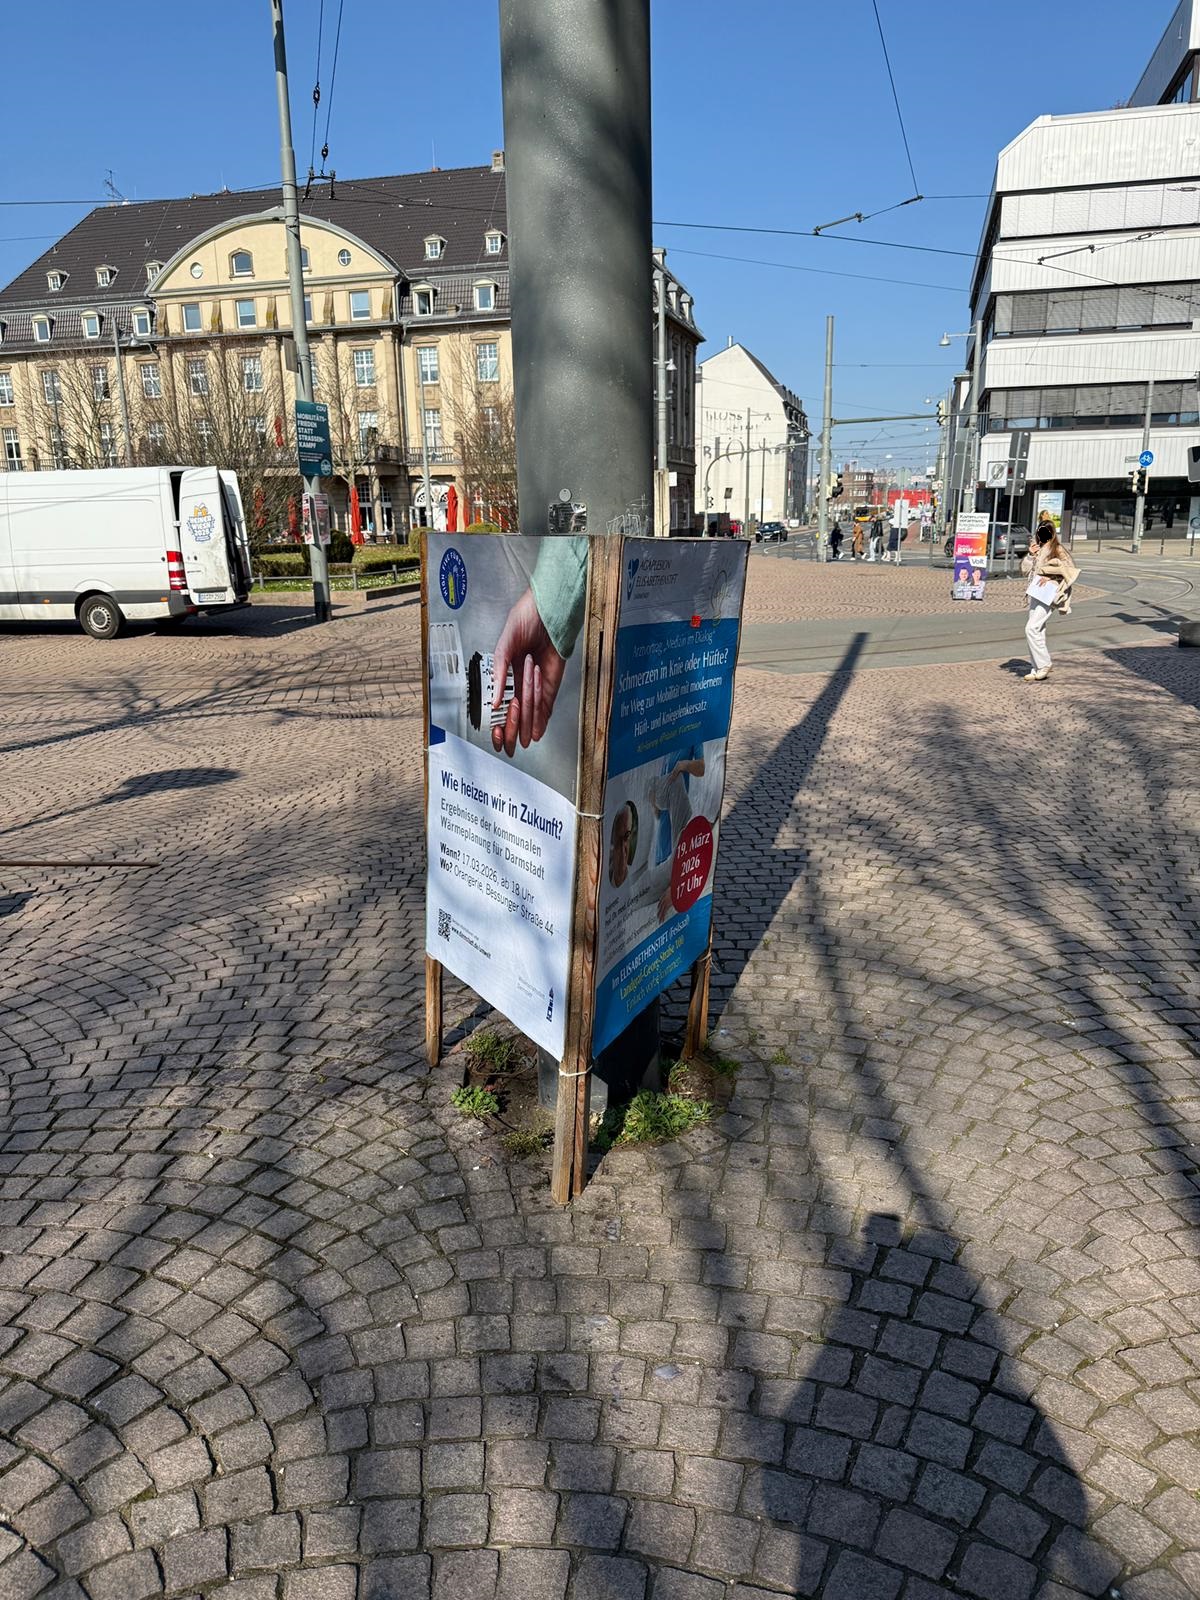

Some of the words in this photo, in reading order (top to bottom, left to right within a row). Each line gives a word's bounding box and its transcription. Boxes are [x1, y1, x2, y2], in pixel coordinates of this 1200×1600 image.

[296, 412, 326, 422] MOBILITÄTS-
[297, 420, 318, 428] FRIEDEN
[298, 434, 326, 442] STRASSEN-
[618, 668, 659, 693] Schmerzen
[660, 661, 668, 680] in
[669, 657, 684, 677] Knie
[684, 653, 701, 672] oder
[702, 648, 729, 668] Hüfte?
[620, 701, 630, 718] Ihr
[630, 697, 645, 715] Weg
[646, 695, 656, 708] zur
[656, 683, 680, 704] Mobilität
[680, 680, 690, 694] mit
[690, 676, 722, 692] modernem
[634, 717, 650, 737] Hüft-
[650, 712, 662, 731] und
[662, 700, 708, 725] Kniegelenkersatz
[441, 770, 458, 792] Wie
[460, 778, 489, 806] heizen
[491, 794, 506, 814] wir
[508, 798, 518, 819] in
[520, 803, 564, 840] Zukunft?
[440, 798, 479, 825] Ergebnisse
[480, 816, 492, 832] der
[493, 823, 542, 858] kommunalen
[440, 815, 491, 854] Wärmeplanung
[492, 840, 504, 857] für
[504, 847, 545, 881] Darmstadt
[676, 844, 688, 860] 19.
[690, 832, 711, 852] März
[440, 842, 460, 861] Wann?
[462, 853, 499, 884] 17.03.2026,
[500, 876, 510, 890] ab
[511, 880, 520, 896] 18
[522, 888, 535, 904] Uhr
[680, 854, 700, 878] 2026
[440, 857, 453, 874] Wo?
[454, 865, 484, 894] Orangerie,
[485, 884, 520, 913] Bessunger
[520, 904, 544, 930] Straße
[544, 920, 554, 937] 44
[676, 882, 684, 900] 17
[687, 875, 704, 893] Uhr
[612, 977, 620, 991] Im
[620, 931, 668, 983] ELISABETHENSTIFT
